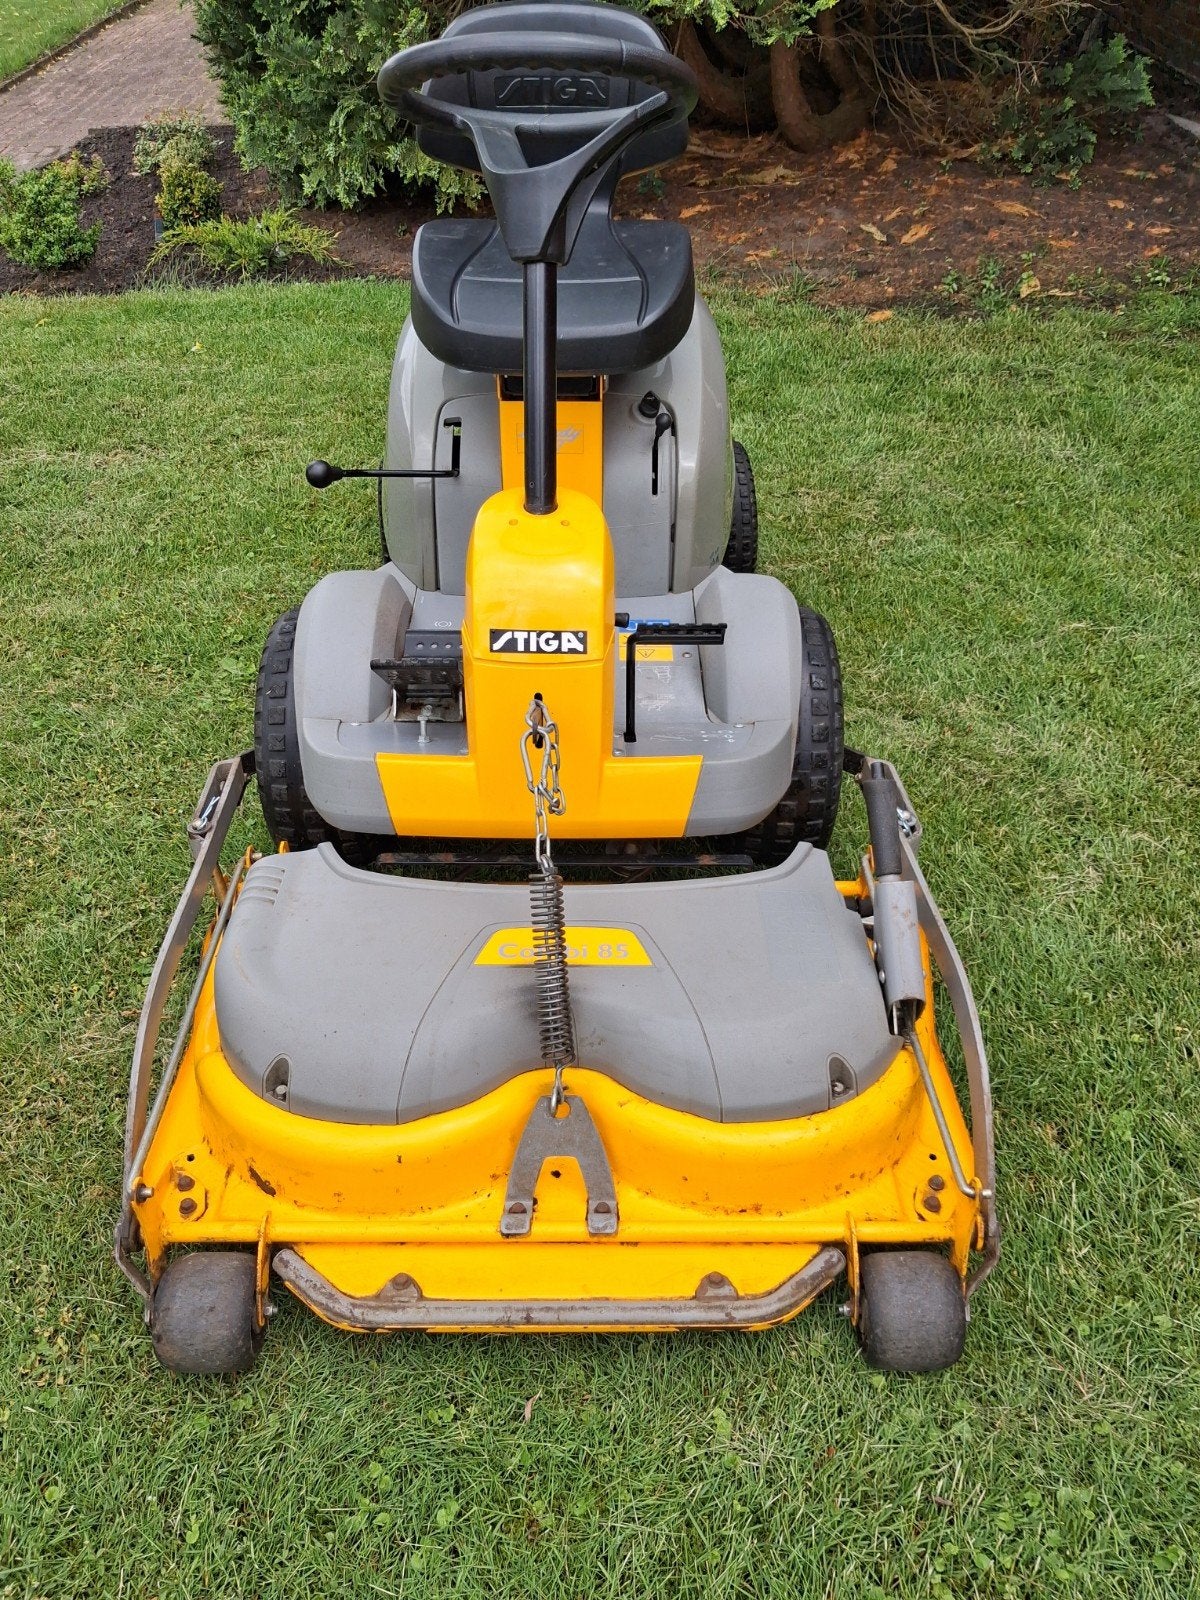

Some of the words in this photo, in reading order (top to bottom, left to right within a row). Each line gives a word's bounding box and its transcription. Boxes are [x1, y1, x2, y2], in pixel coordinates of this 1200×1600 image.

[498, 77, 606, 103] STIGA
[492, 630, 585, 653] STIGA
[498, 942, 588, 959] Cobi
[597, 942, 630, 959] 85
